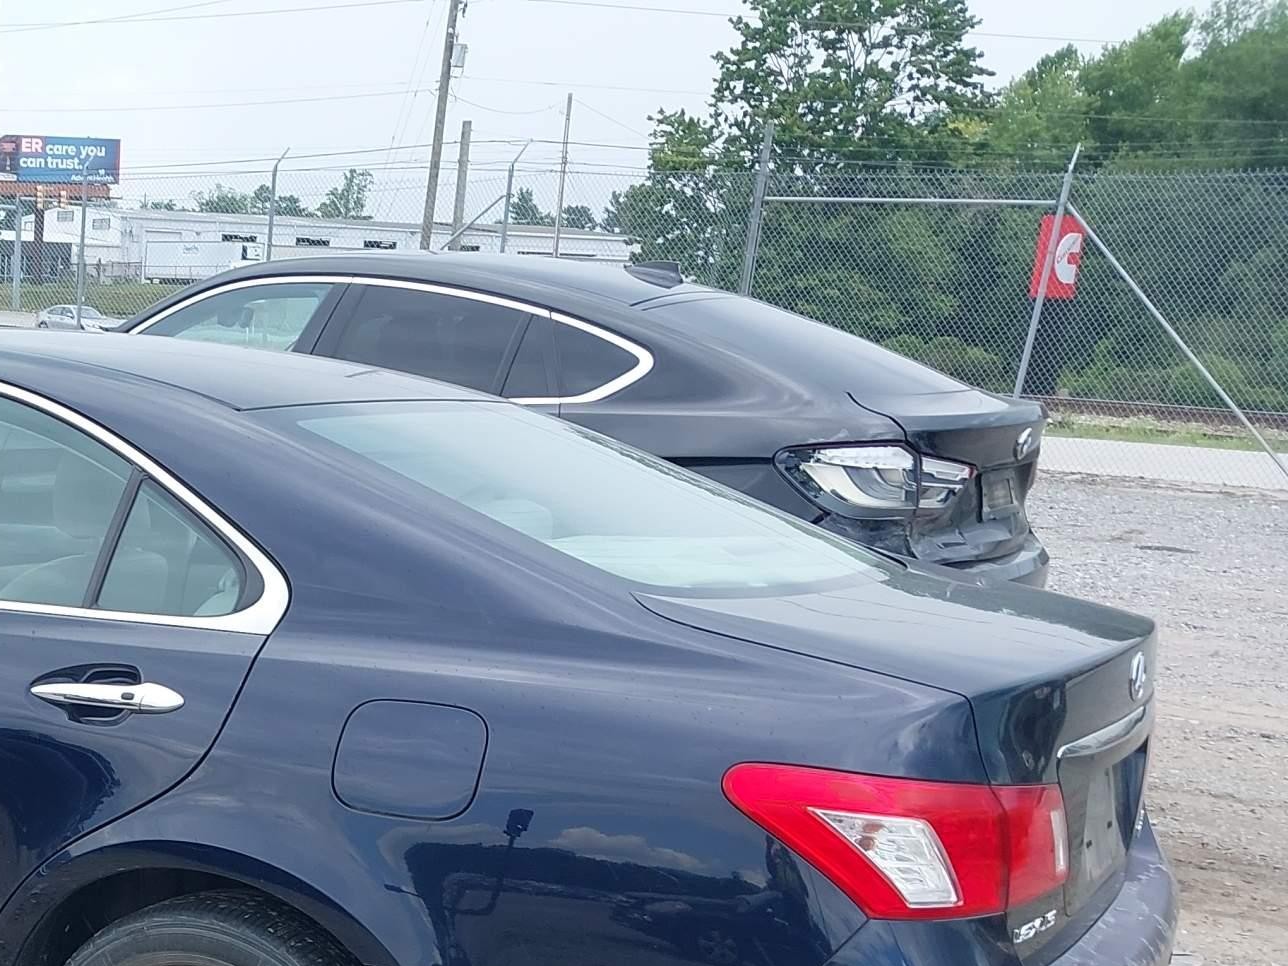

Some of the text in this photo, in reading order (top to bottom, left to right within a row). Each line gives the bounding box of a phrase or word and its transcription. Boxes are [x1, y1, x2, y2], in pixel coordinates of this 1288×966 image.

[21, 137, 43, 153] ER
[45, 144, 77, 156] care
[79, 145, 106, 159] you
[19, 156, 83, 169] can trust.
